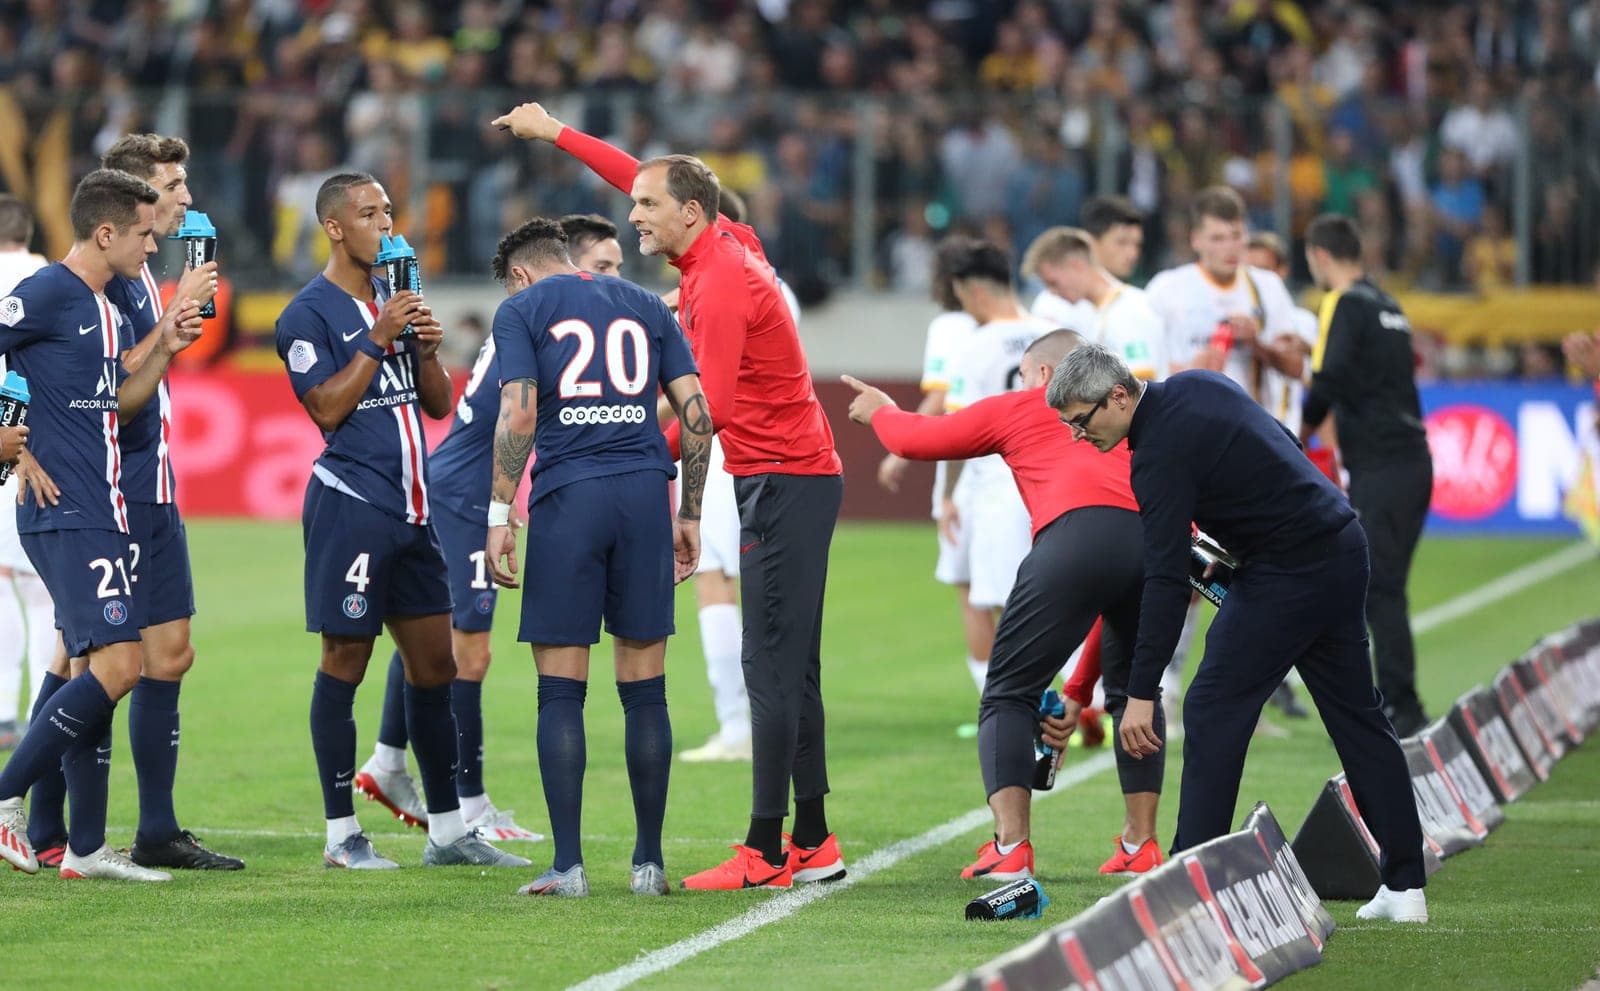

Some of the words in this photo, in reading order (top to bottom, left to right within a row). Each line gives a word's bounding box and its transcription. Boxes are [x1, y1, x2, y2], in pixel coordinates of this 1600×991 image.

[549, 317, 650, 399] 20
[560, 405, 646, 424] ooredoo
[89, 557, 131, 598] 21
[345, 553, 370, 592] 4
[469, 550, 499, 589] 1
[50, 716, 78, 738] PARIS
[988, 881, 1035, 909] POWERADE
